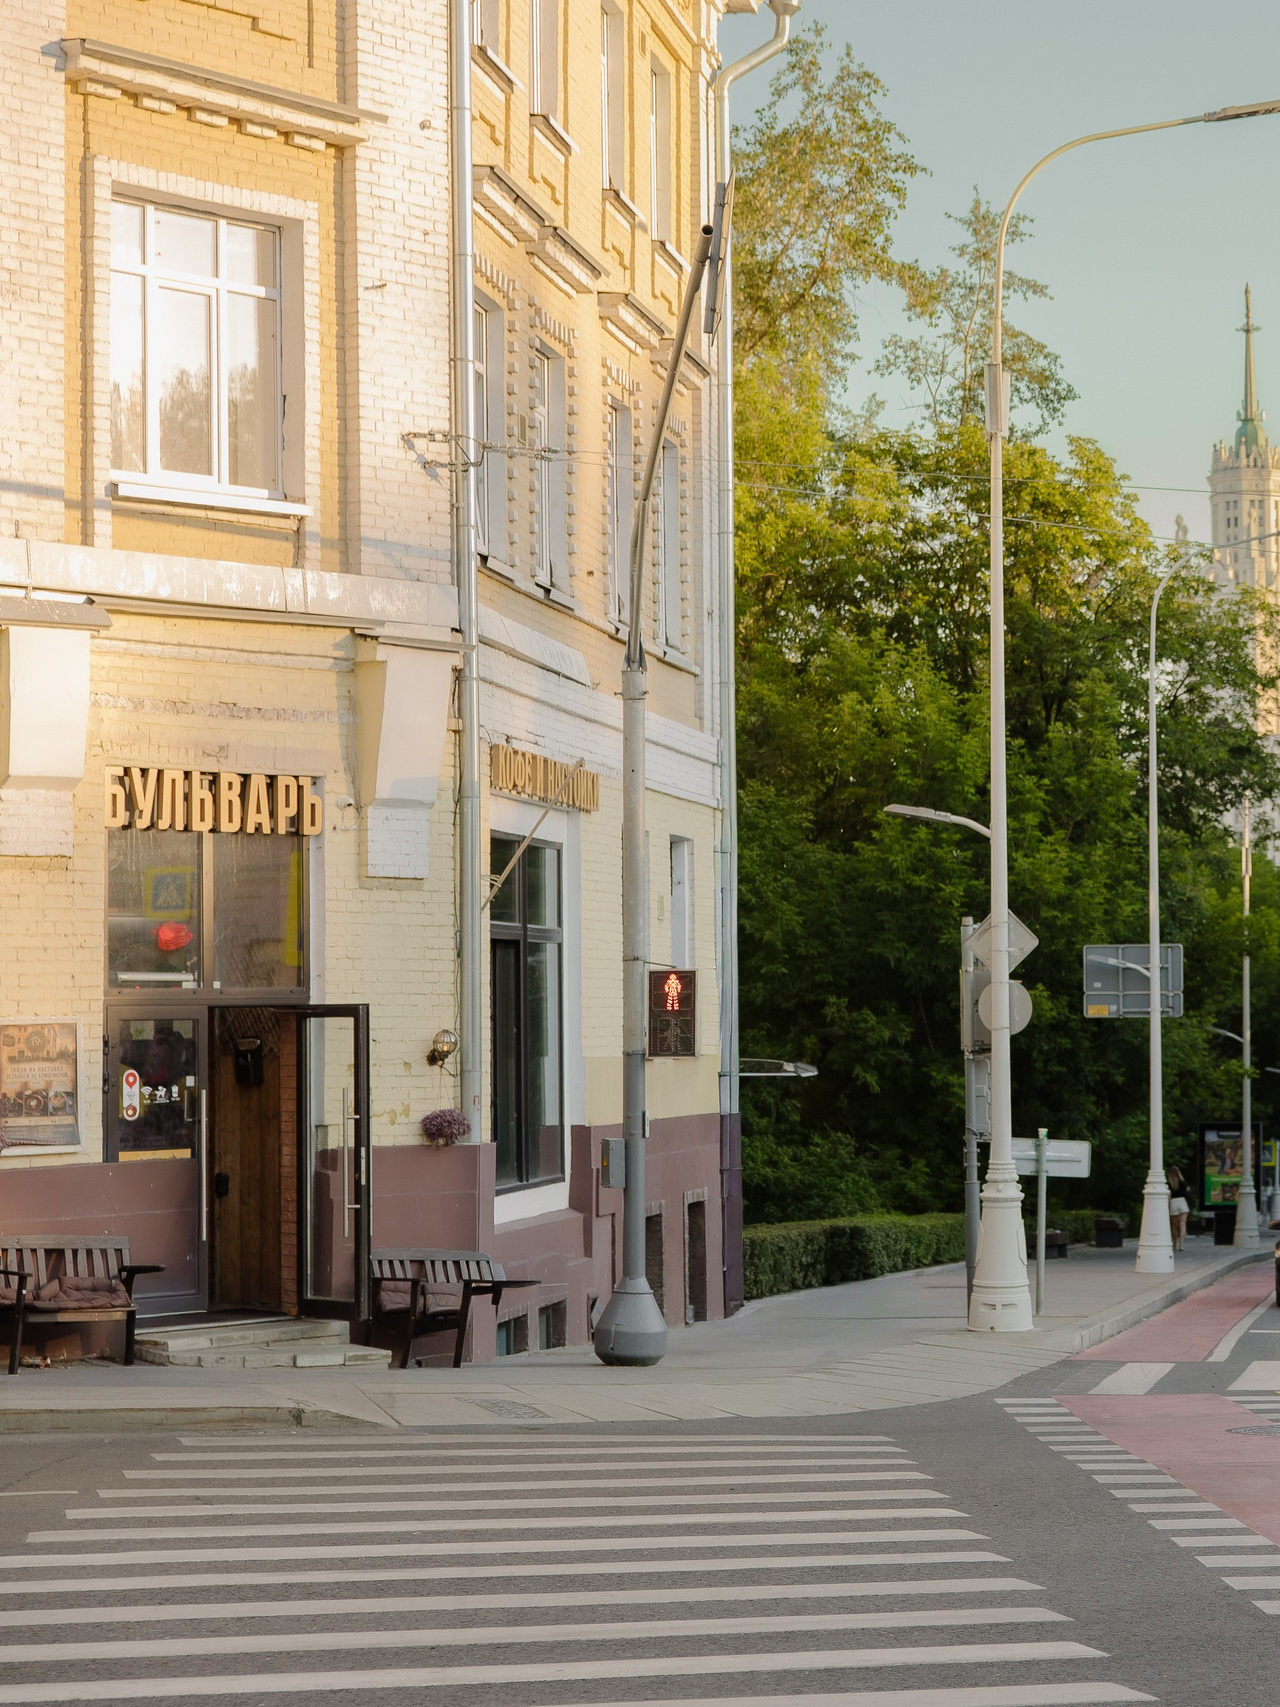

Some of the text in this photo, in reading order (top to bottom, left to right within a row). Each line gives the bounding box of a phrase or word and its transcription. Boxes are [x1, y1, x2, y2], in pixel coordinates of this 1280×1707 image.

[105, 766, 322, 836] БУЛЬВАРЪ
[499, 745, 532, 798] КОФЕ
[536, 755, 545, 798] И
